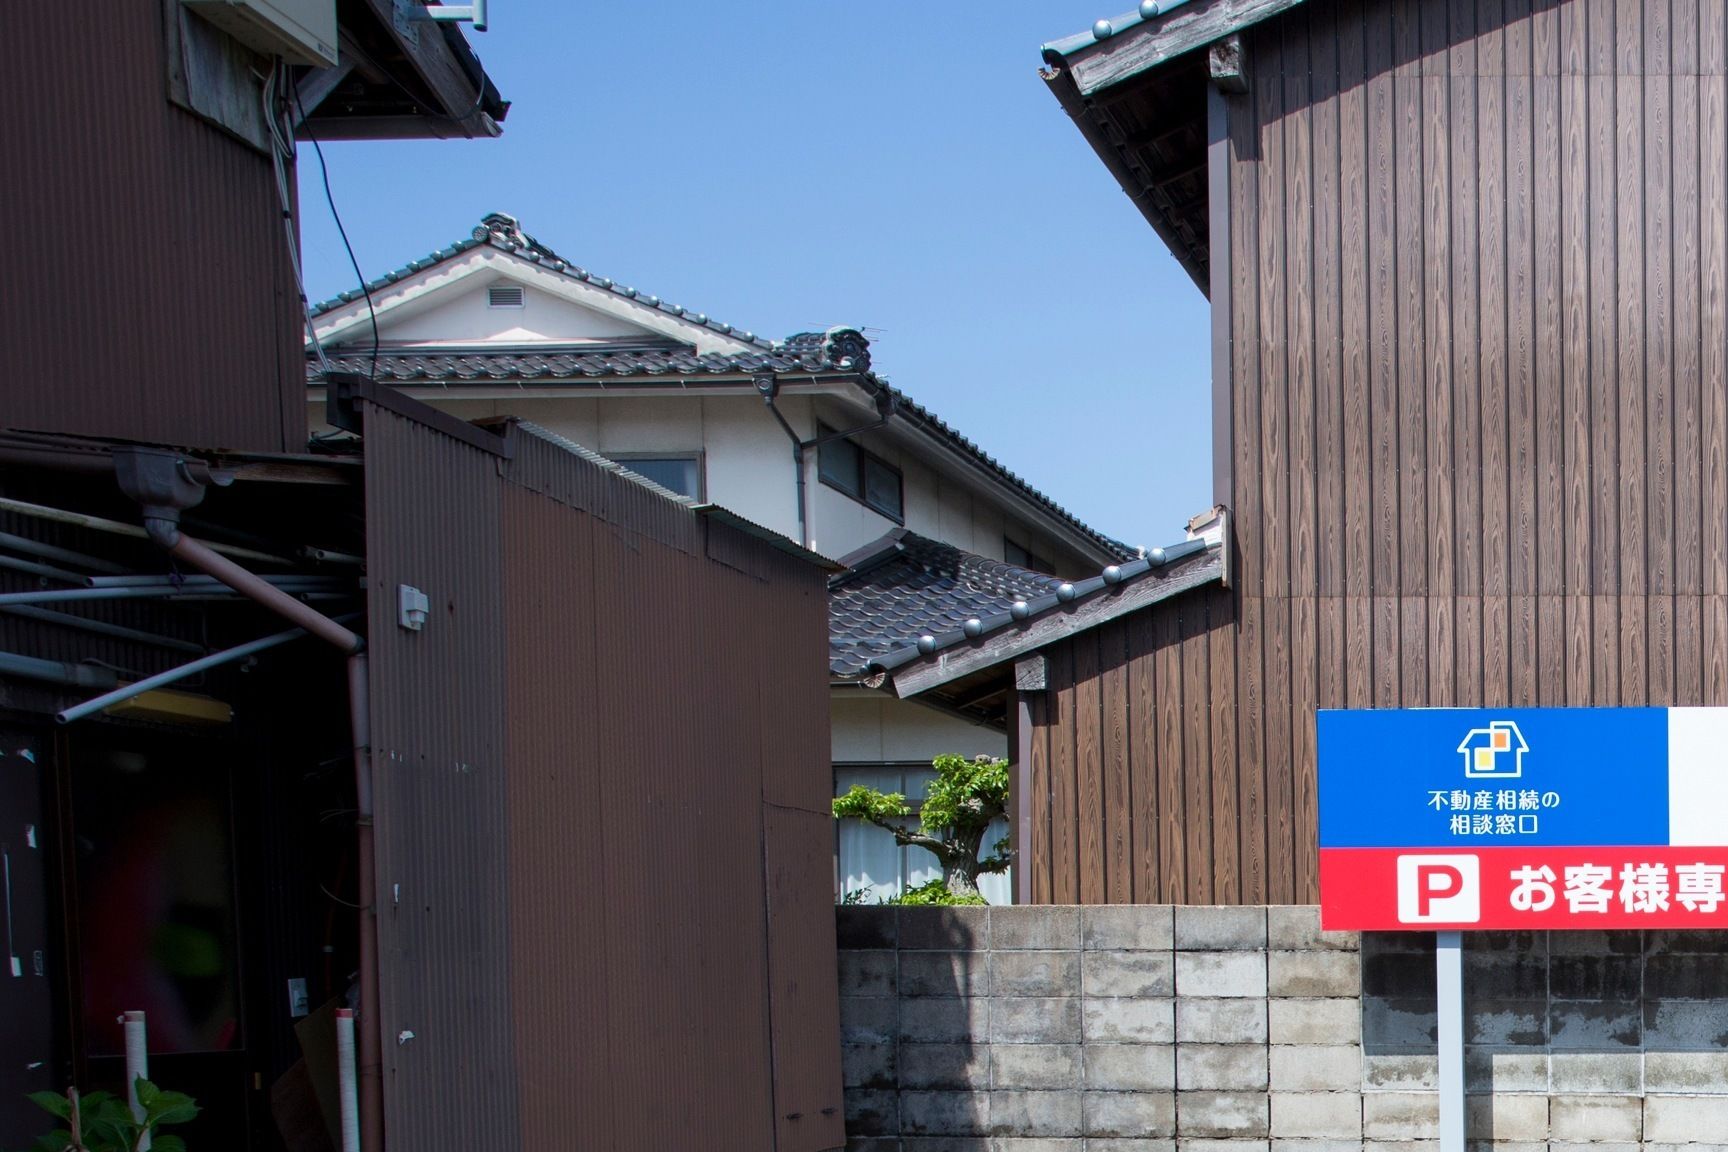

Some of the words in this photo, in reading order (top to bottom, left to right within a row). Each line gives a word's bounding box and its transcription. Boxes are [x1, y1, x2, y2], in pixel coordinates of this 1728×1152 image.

[1427, 790, 1561, 811] 不動産相続の
[1449, 814, 1538, 835] 相談窓口
[1418, 865, 1463, 917] P
